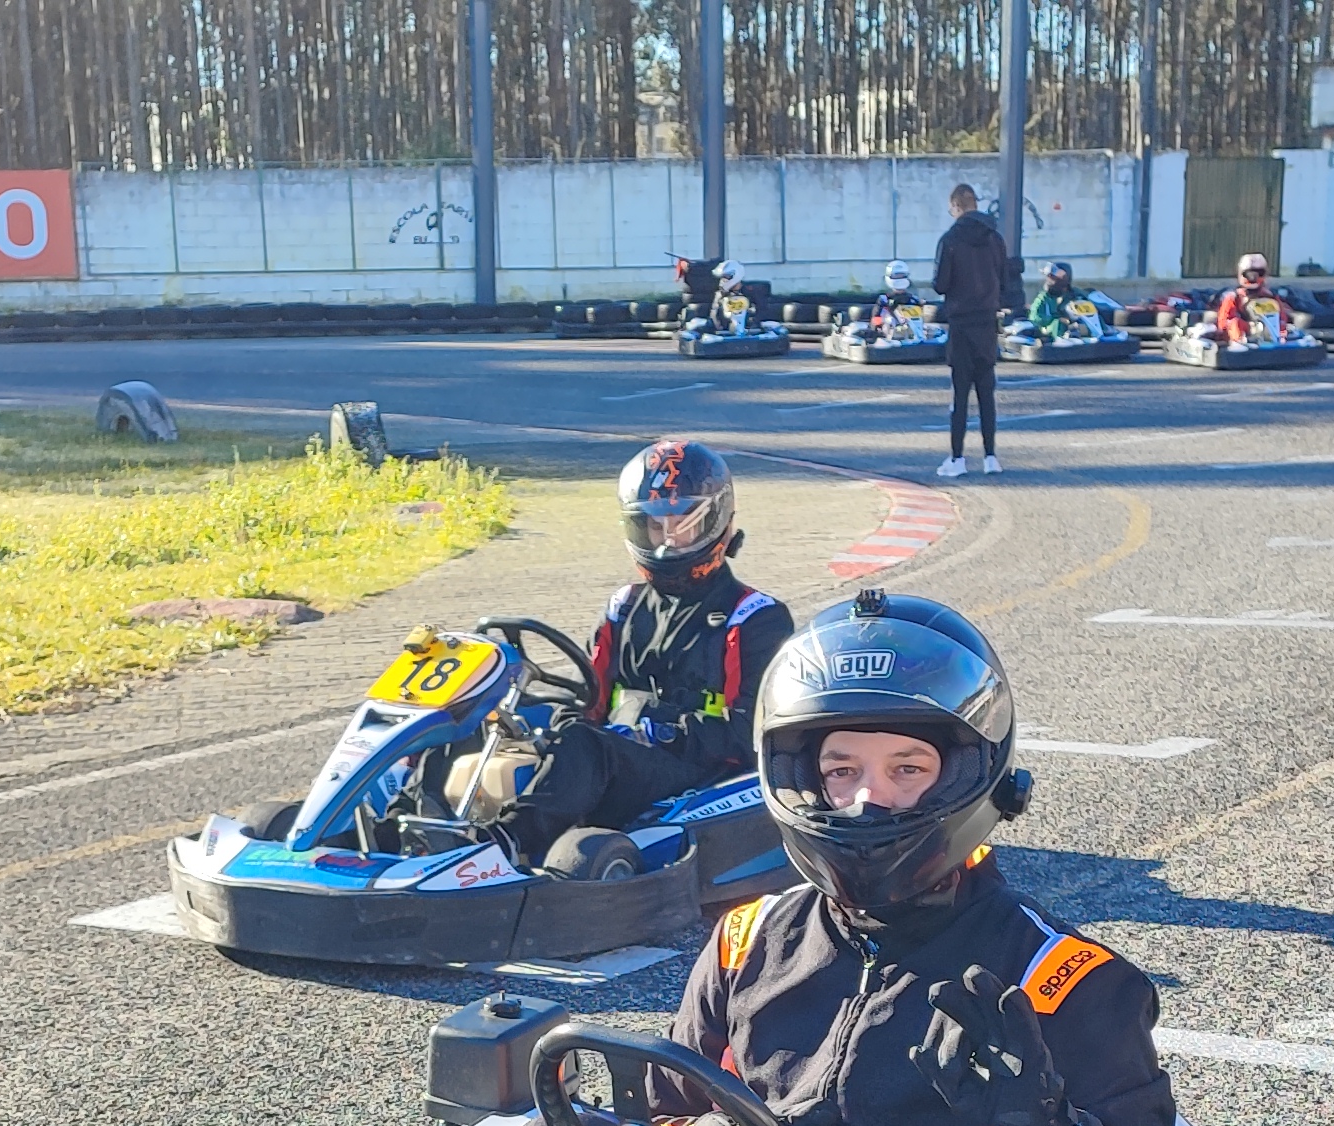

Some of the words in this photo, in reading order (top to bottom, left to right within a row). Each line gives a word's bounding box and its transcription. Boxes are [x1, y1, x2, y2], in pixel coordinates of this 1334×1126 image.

[399, 655, 463, 692] 18
[837, 653, 889, 679] agv
[1038, 950, 1097, 1001] sparco
